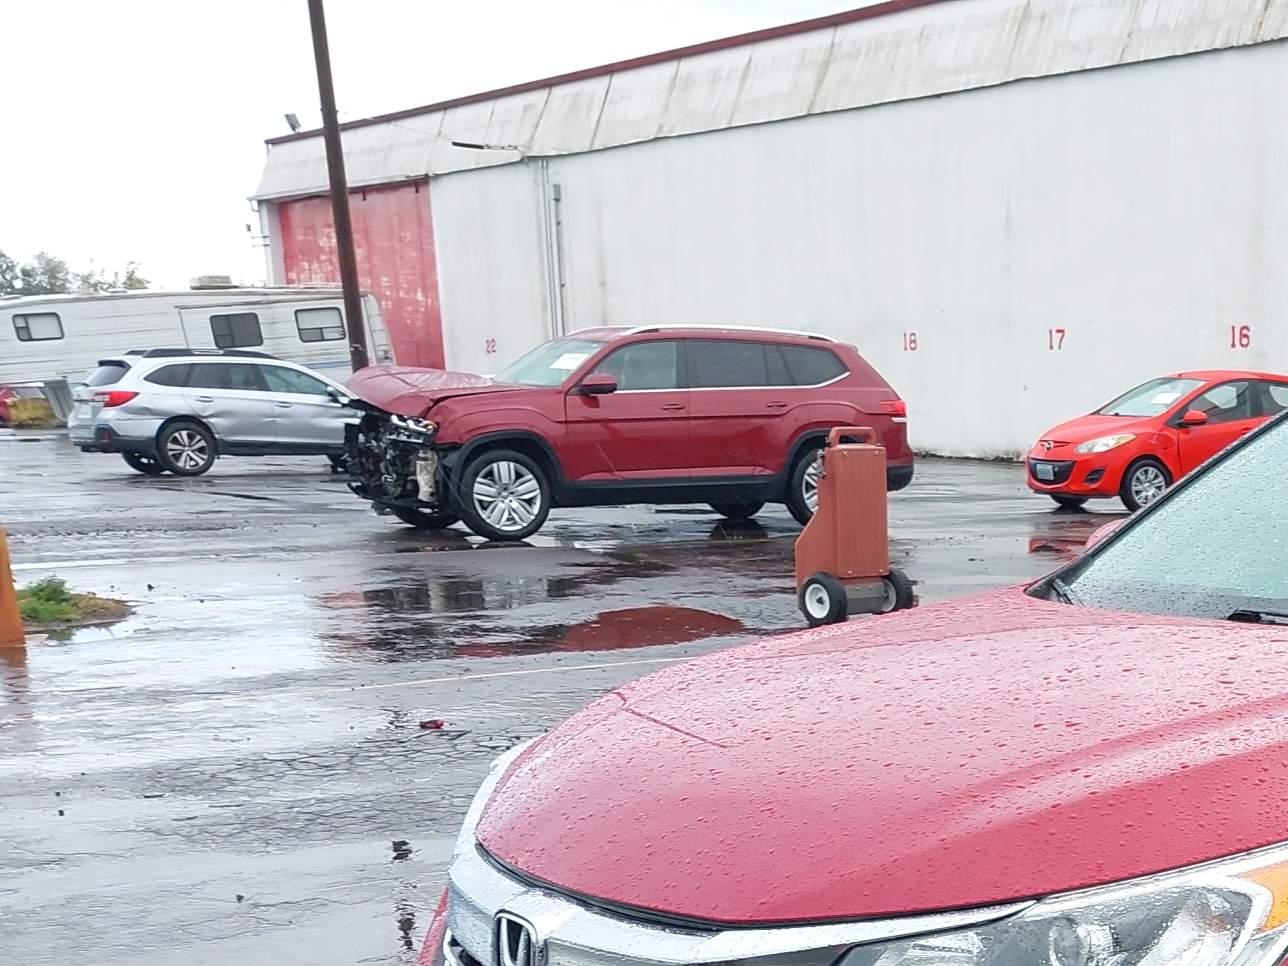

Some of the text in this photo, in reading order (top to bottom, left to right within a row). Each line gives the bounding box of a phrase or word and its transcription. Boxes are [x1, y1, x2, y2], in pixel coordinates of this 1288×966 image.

[903, 332, 917, 351] 18
[1048, 328, 1065, 350] 17
[1230, 325, 1250, 349] 16
